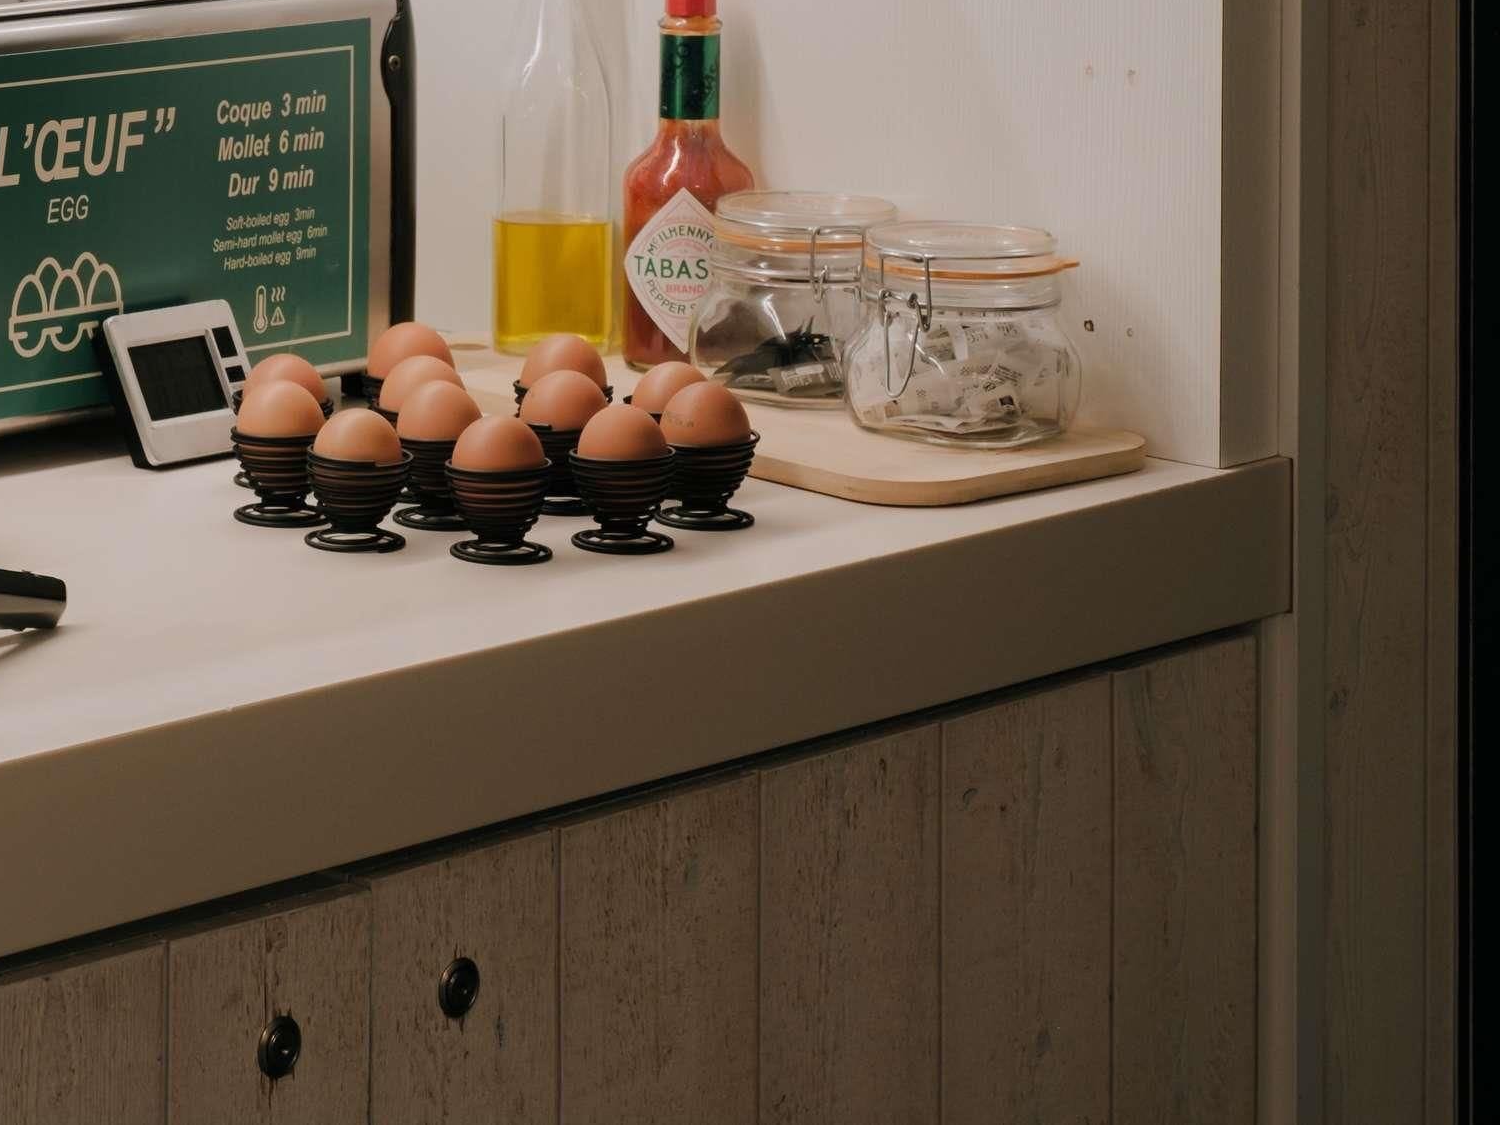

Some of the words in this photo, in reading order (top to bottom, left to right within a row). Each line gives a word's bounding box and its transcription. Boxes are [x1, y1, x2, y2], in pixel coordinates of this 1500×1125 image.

[217, 100, 272, 127] Coque
[281, 93, 292, 117] 3
[295, 89, 327, 115] min
[218, 133, 270, 162] Mollet
[279, 129, 289, 154] 6
[293, 126, 325, 152] min
[228, 172, 260, 197] Dur
[268, 167, 279, 192] 9
[282, 164, 314, 190] min
[47, 194, 90, 224] EGG
[226, 212, 273, 231] Soft-boiled
[273, 212, 290, 227] egg
[294, 206, 316, 222] 3min
[212, 234, 258, 253] Semi-hard
[258, 230, 285, 246] mollet
[286, 229, 303, 245] egg
[306, 223, 328, 239] 6min
[223, 251, 274, 271] Hard-boiled
[275, 251, 292, 266] egg
[646, 279, 687, 315] PEPPER
